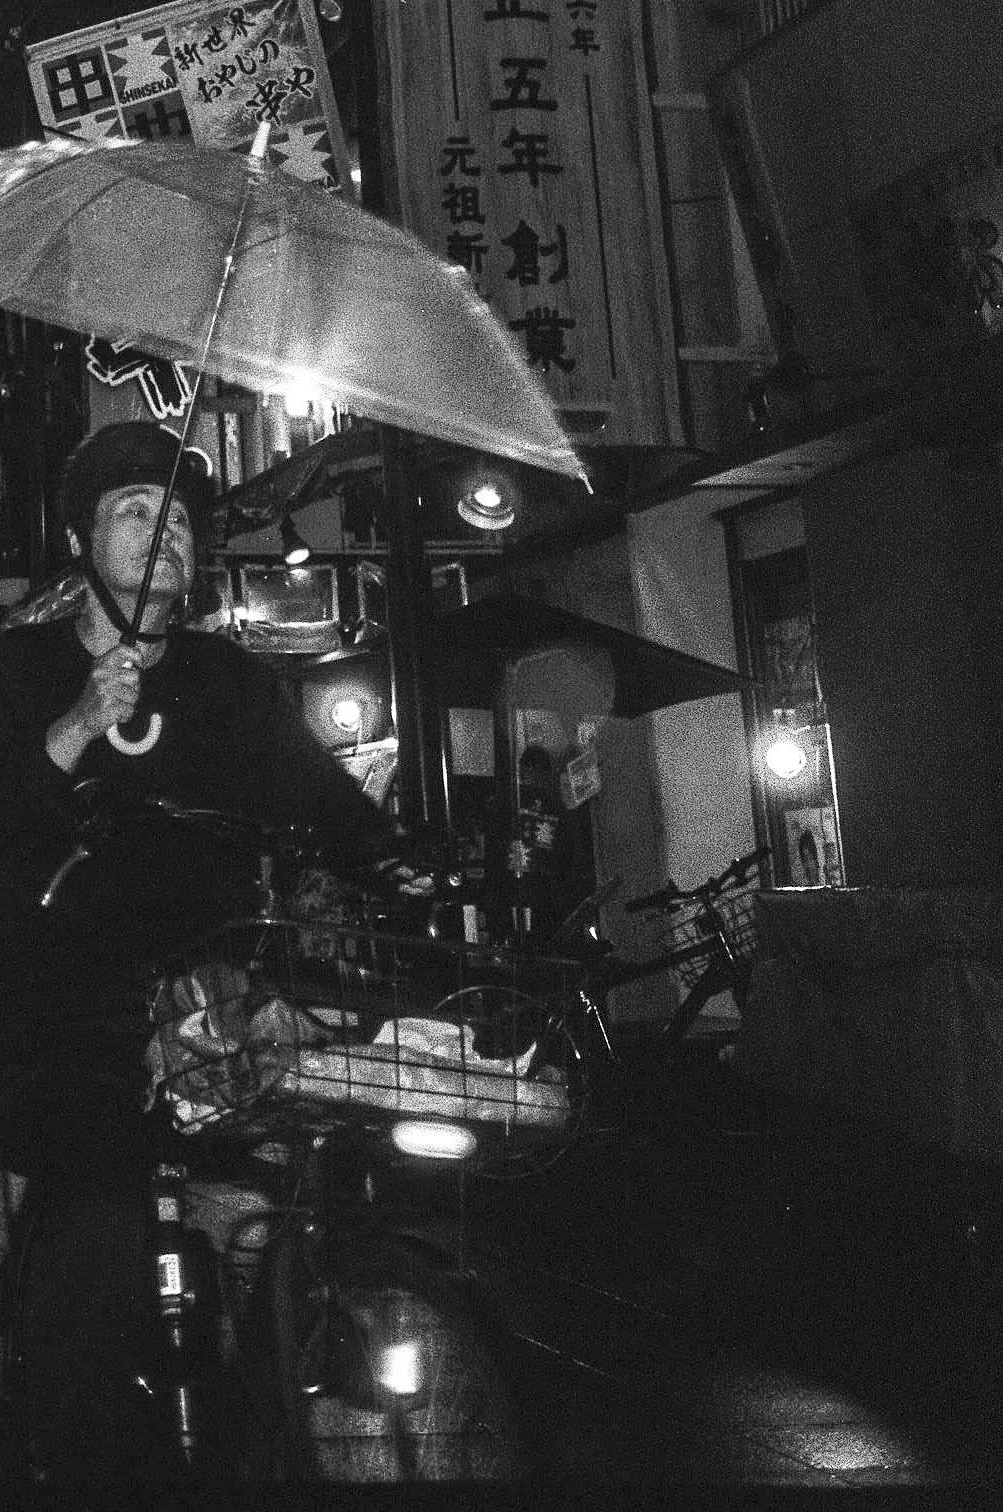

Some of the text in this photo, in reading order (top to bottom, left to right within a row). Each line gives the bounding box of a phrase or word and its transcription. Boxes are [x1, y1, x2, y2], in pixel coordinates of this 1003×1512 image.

[175, 7, 256, 71] 新世界
[198, 40, 281, 103] おやじの
[440, 136, 490, 282] 元祖新
